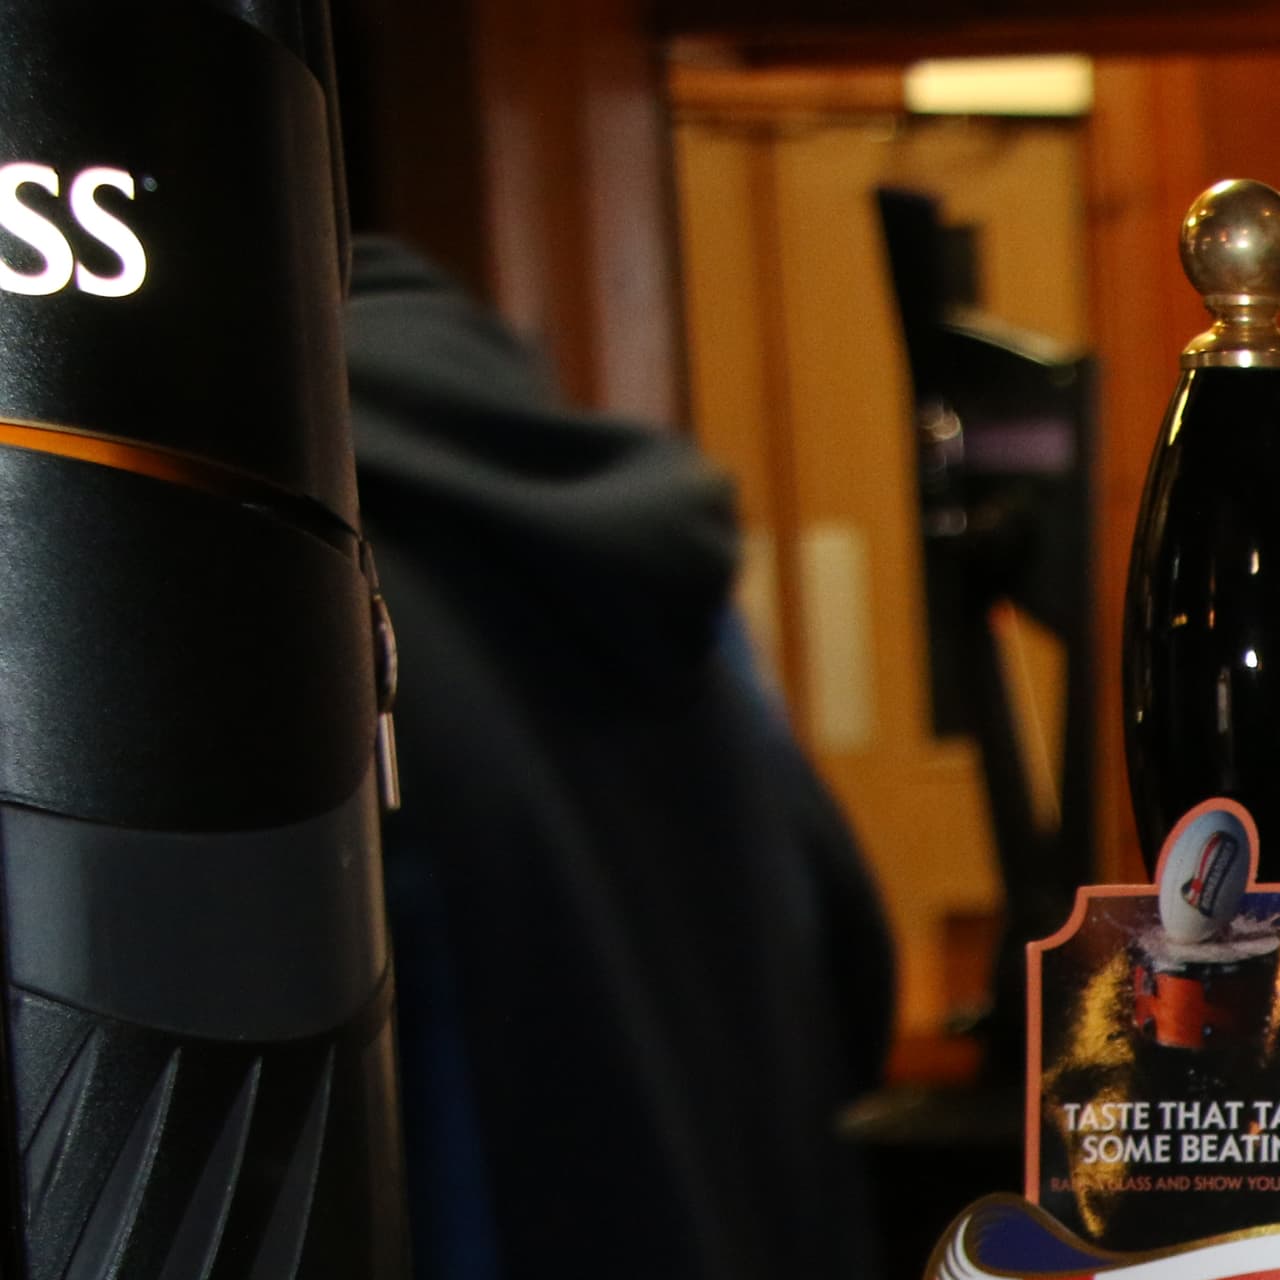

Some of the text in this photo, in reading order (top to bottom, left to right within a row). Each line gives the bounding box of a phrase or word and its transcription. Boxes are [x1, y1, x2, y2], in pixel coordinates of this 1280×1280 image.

[1063, 1101, 1151, 1131] TASTE
[1158, 1101, 1245, 1131] THAT
[1082, 1134, 1172, 1163] SOME
[1107, 1175, 1152, 1192] GLASS
[1155, 1175, 1191, 1191] AND
[1194, 1175, 1243, 1192] SHOW
